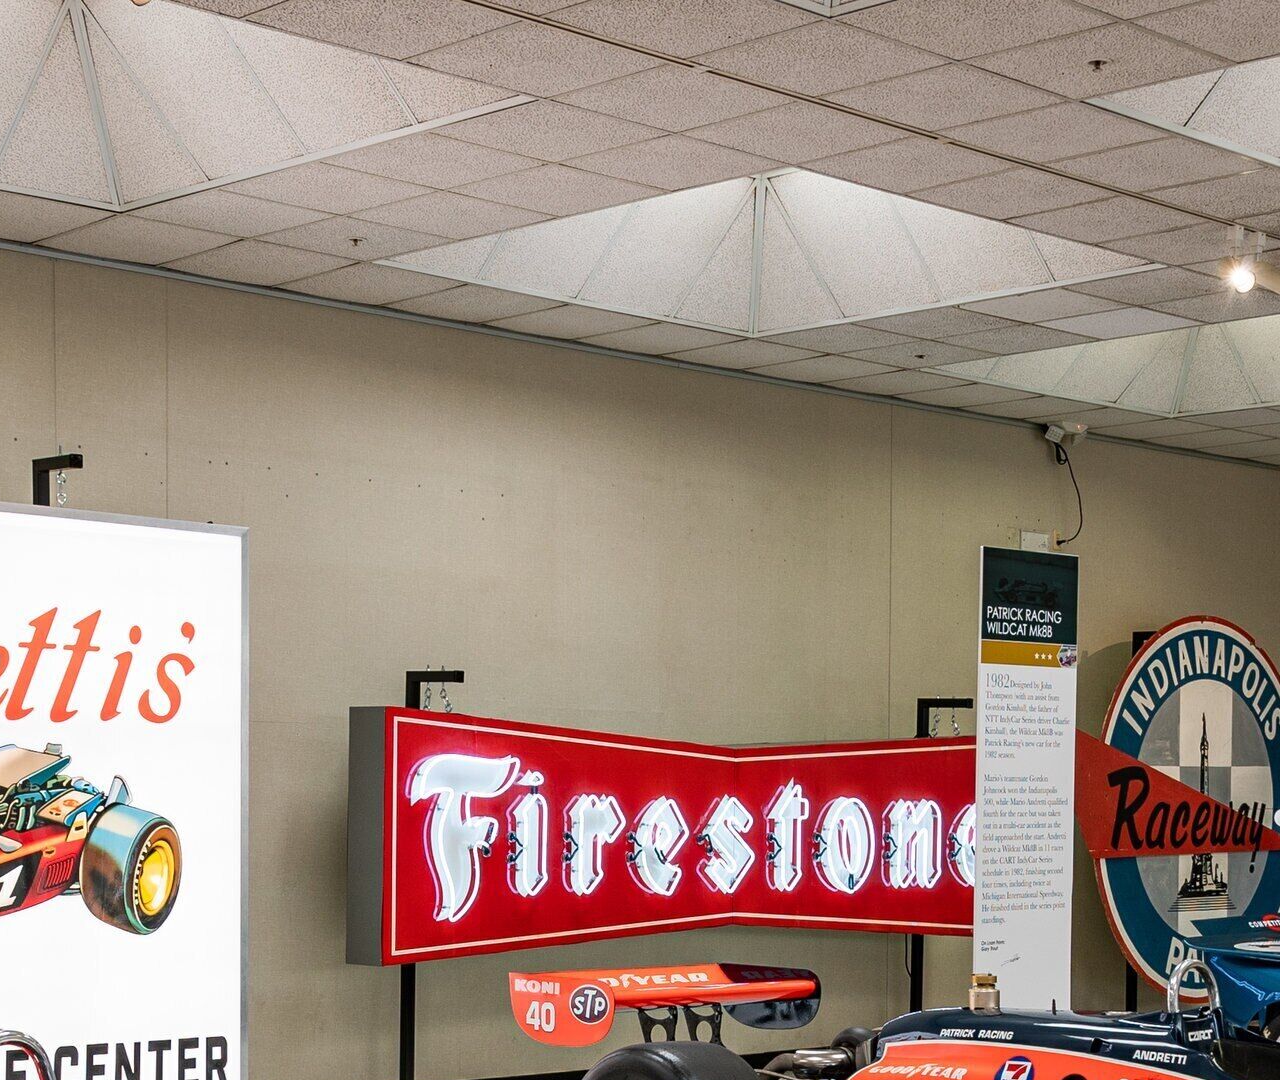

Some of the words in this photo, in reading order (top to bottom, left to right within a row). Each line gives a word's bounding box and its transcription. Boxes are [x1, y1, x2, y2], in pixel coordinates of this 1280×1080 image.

[987, 606, 1023, 621] PATRICK
[1026, 608, 1062, 624] RACING
[987, 621, 1027, 636] WILDCAT
[1029, 624, 1052, 638] Mk8B
[986, 673, 1010, 688] 1982
[514, 979, 560, 995] KONI
[573, 988, 606, 1019] STP
[525, 1001, 555, 1033] 40
[939, 1027, 975, 1039] PATRICK
[977, 1029, 1013, 1040] RACING
[1132, 1049, 1188, 1065] ANDRETTI
